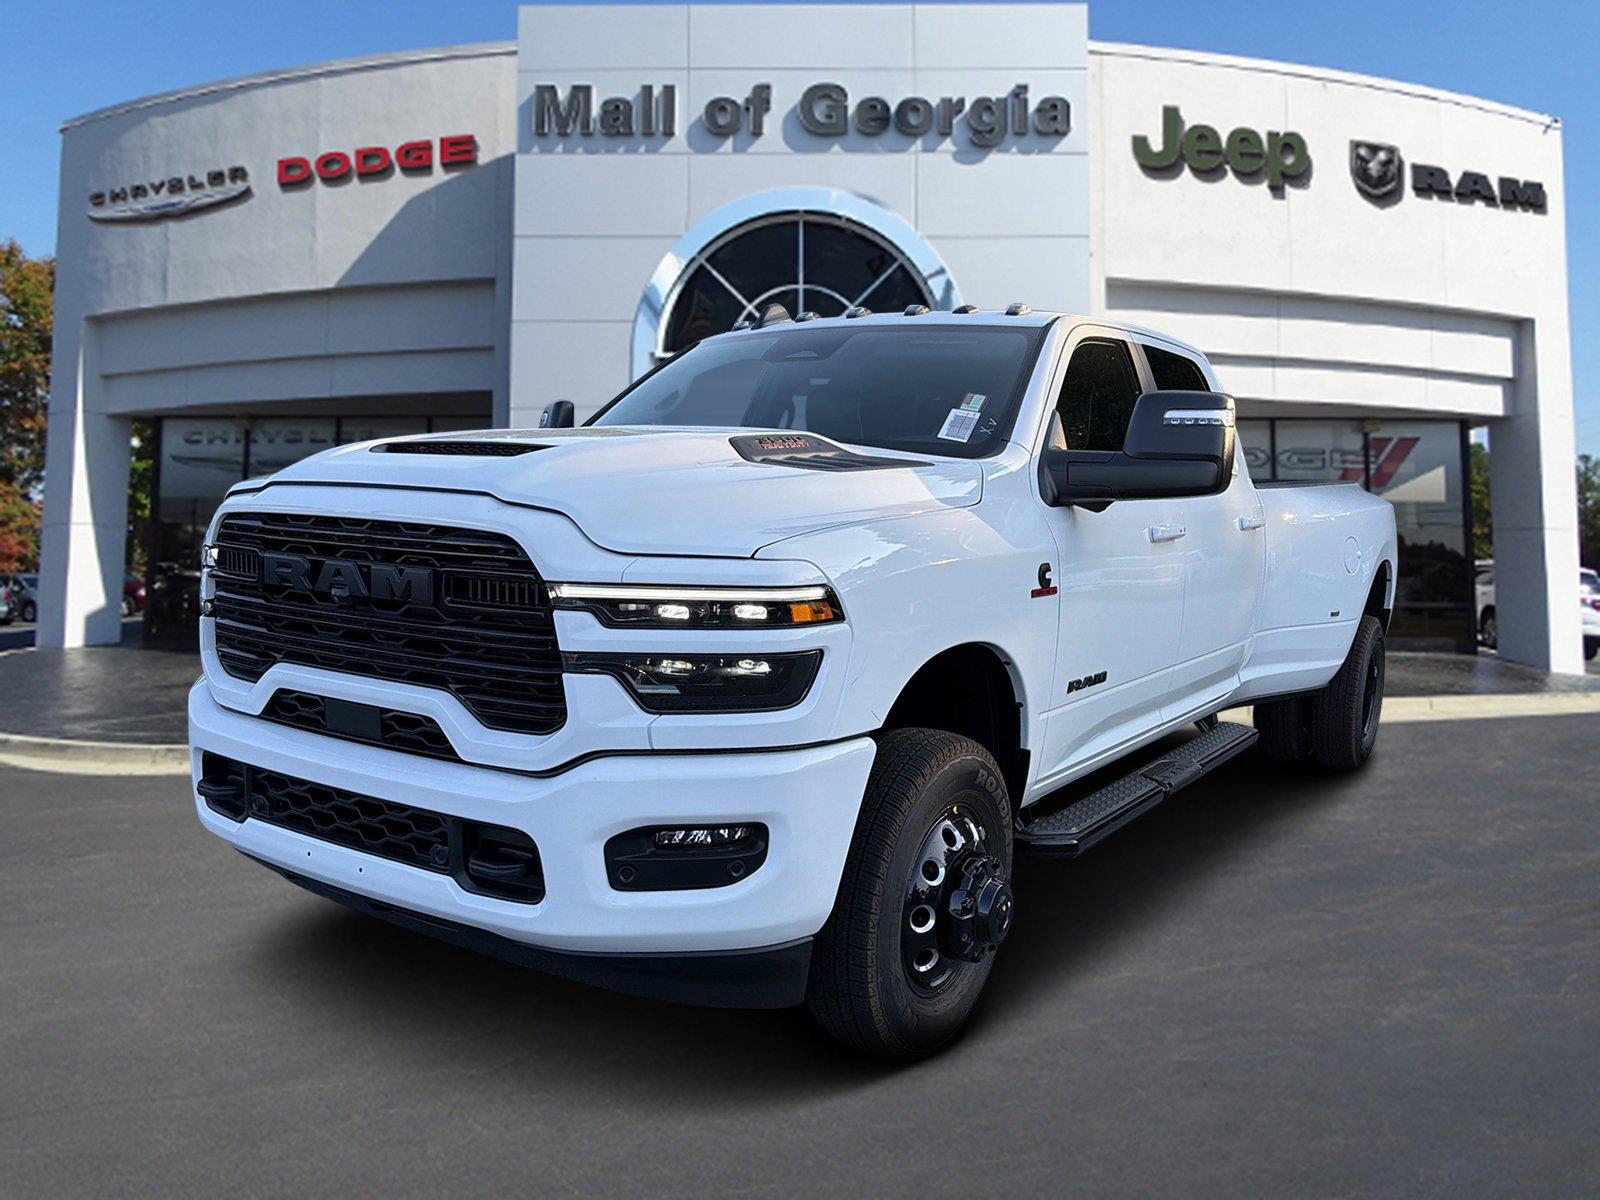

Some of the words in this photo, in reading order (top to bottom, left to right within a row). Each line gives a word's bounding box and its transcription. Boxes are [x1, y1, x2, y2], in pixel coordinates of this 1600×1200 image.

[532, 84, 678, 138] Mall
[703, 83, 772, 137] of
[799, 83, 1073, 148] Georgia
[276, 134, 478, 188] DODGE
[1131, 105, 1312, 198] Jeep
[89, 165, 250, 208] CHRYSLER
[1410, 162, 1549, 215] RAM
[263, 551, 433, 602] RAM
[1066, 670, 1108, 694] RAM
